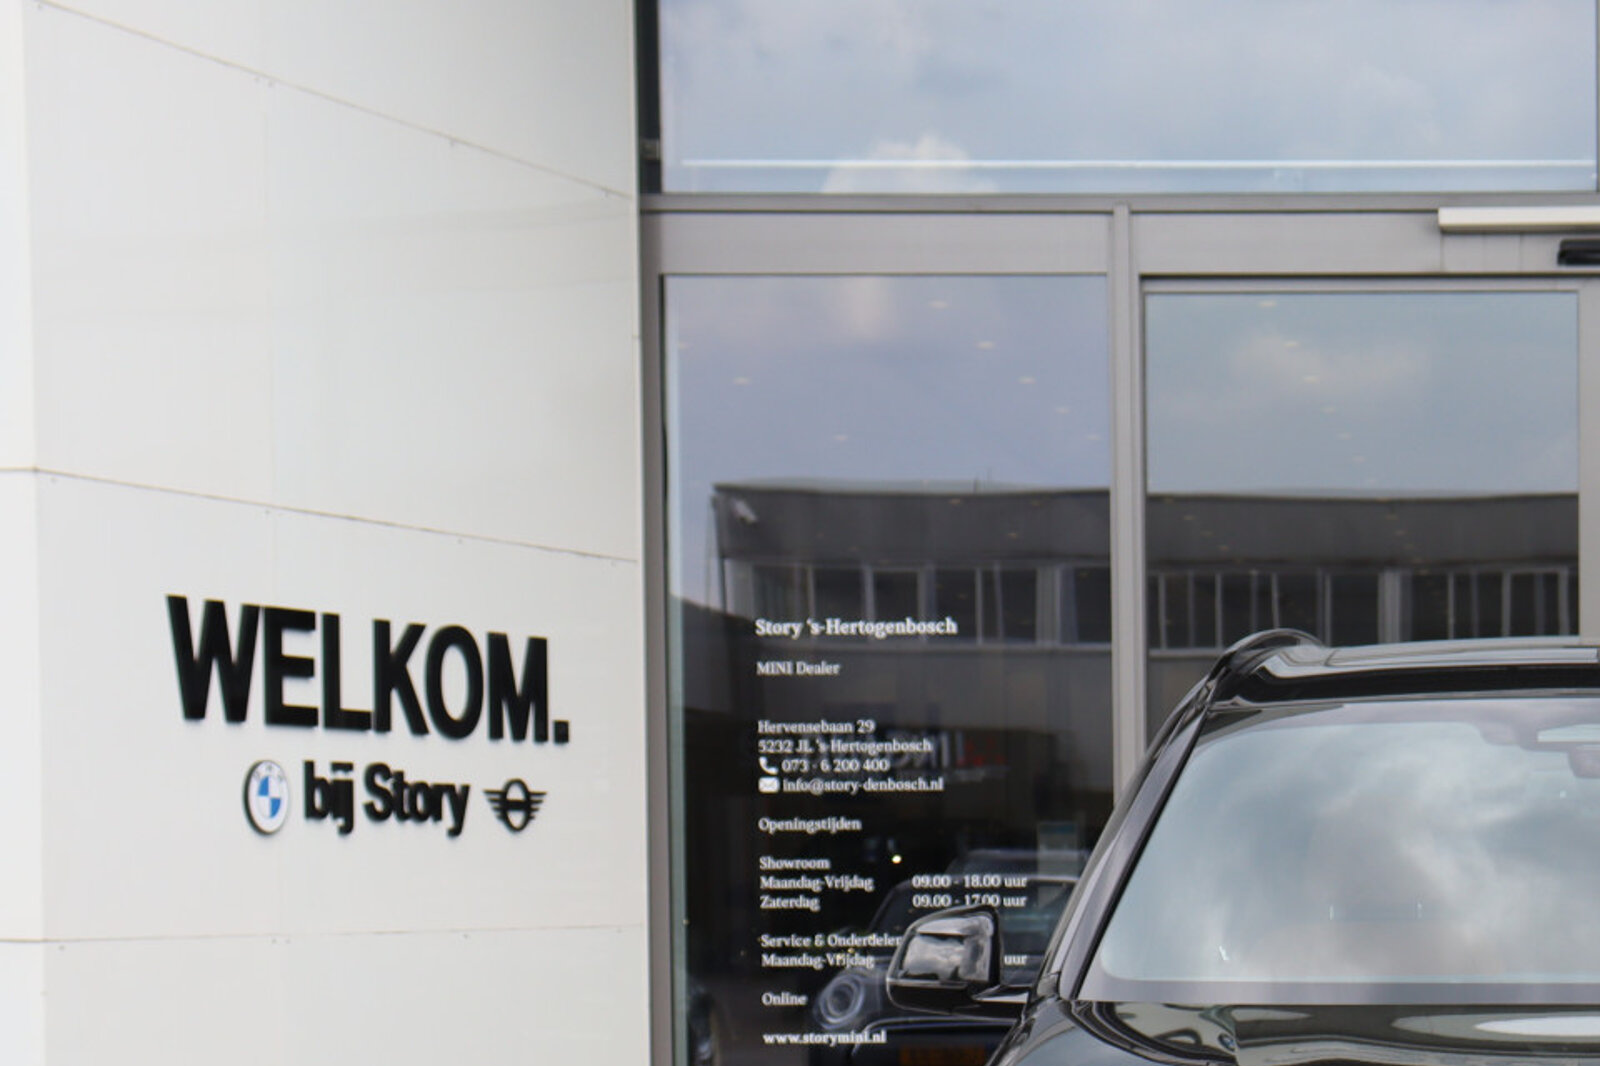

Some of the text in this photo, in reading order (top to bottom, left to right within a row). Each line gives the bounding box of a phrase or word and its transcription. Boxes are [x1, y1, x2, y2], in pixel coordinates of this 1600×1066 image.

[755, 619, 803, 640] Story
[166, 594, 571, 745] WELKOM.
[757, 660, 840, 676] MINI Dealer
[757, 719, 876, 734] Hervensebaan 29
[758, 739, 793, 754] 5232
[796, 739, 813, 754] JL
[781, 759, 810, 773] 073
[820, 760, 831, 773] 6
[833, 759, 860, 773] 200
[862, 758, 891, 773] 400
[782, 776, 944, 796] info@story-denbosch.nl
[303, 760, 471, 838] bij Story
[758, 817, 862, 835] Openingstijden
[759, 856, 831, 870] Showroom
[759, 875, 874, 892] Maandag-Vrijdag
[911, 874, 952, 889] 09.00
[963, 874, 1001, 889] 18.00
[1003, 876, 1028, 888] uur
[759, 894, 820, 912] Zaterdag
[912, 894, 953, 908] 09.00
[964, 894, 1000, 907] 1700
[1002, 896, 1028, 908] uur
[760, 933, 812, 947] Service
[814, 933, 825, 947] &
[761, 953, 1028, 970] Maandag-Vrijdag uur
[761, 991, 808, 1006] Online
[763, 1029, 888, 1047] www.storymini.nl
